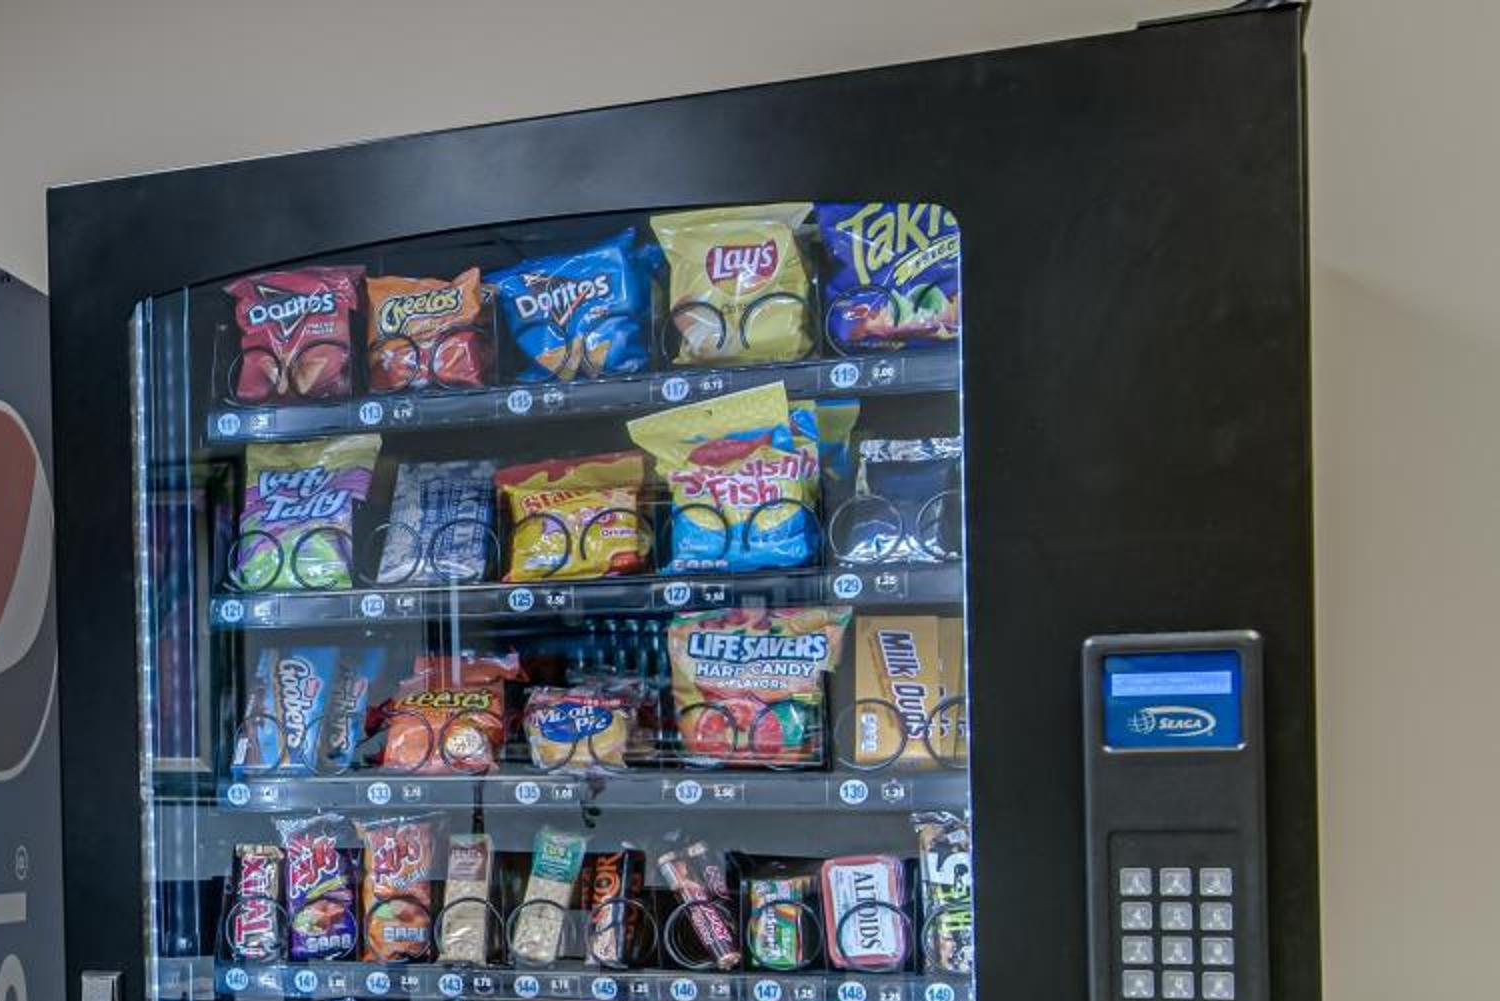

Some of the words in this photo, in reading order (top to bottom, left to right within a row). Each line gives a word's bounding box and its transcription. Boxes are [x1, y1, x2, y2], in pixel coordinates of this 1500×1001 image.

[836, 203, 957, 286] Taki
[516, 274, 610, 320] Doritos
[249, 292, 336, 325] Doritos
[380, 288, 463, 334] Cheetos
[706, 479, 781, 512] Fish
[263, 491, 349, 521] Taffy
[836, 579, 860, 593] 129
[510, 593, 533, 606] 125
[666, 587, 689, 600] 127
[690, 634, 741, 660] LIFE
[742, 634, 827, 663] SAVERS
[879, 631, 920, 677] Milk
[751, 664, 814, 678] CANDY
[279, 658, 313, 749] Goobers
[893, 681, 932, 738] Duds
[1159, 718, 1202, 730] SEAGA
[517, 786, 539, 798] 135
[677, 786, 700, 798] 137
[842, 786, 865, 798] 139
[235, 856, 272, 945] TWIX
[853, 870, 881, 950] ALTOIDS
[226, 974, 247, 986] 140
[296, 975, 316, 987] 141
[367, 977, 389, 989] 142
[440, 979, 462, 991] 143
[516, 980, 538, 993] 144
[593, 982, 615, 995] 145
[672, 984, 695, 997] 146
[756, 985, 779, 998] 147
[840, 987, 864, 1000] 148
[926, 989, 952, 1001] 149
